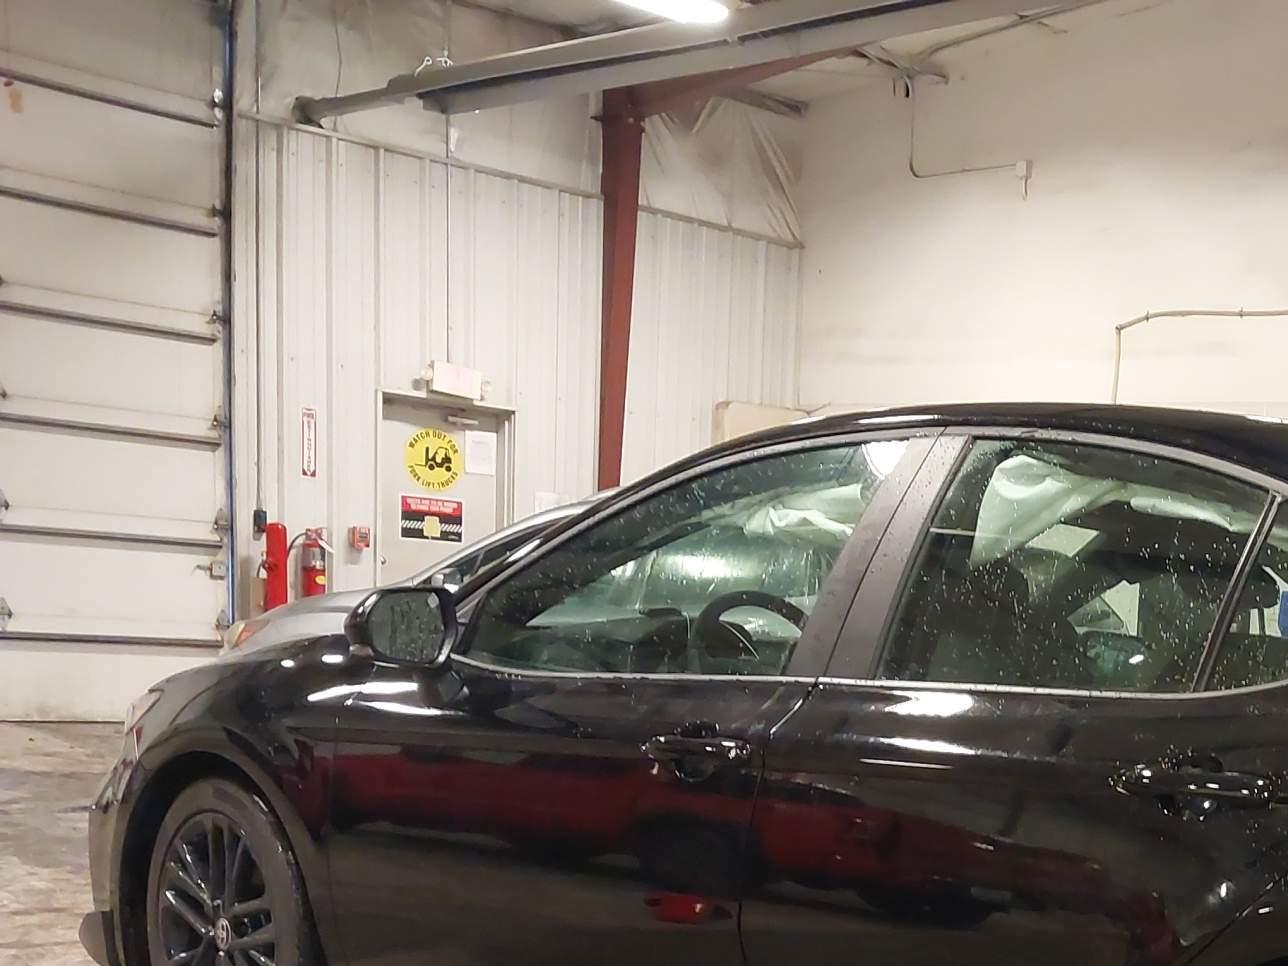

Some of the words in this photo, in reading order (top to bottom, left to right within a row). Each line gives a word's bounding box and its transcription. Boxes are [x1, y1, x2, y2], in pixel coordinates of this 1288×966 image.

[408, 431, 431, 449] WATCH
[432, 431, 447, 441] OUT
[422, 479, 435, 489] LIFT
[437, 471, 458, 489] TRUCKS
